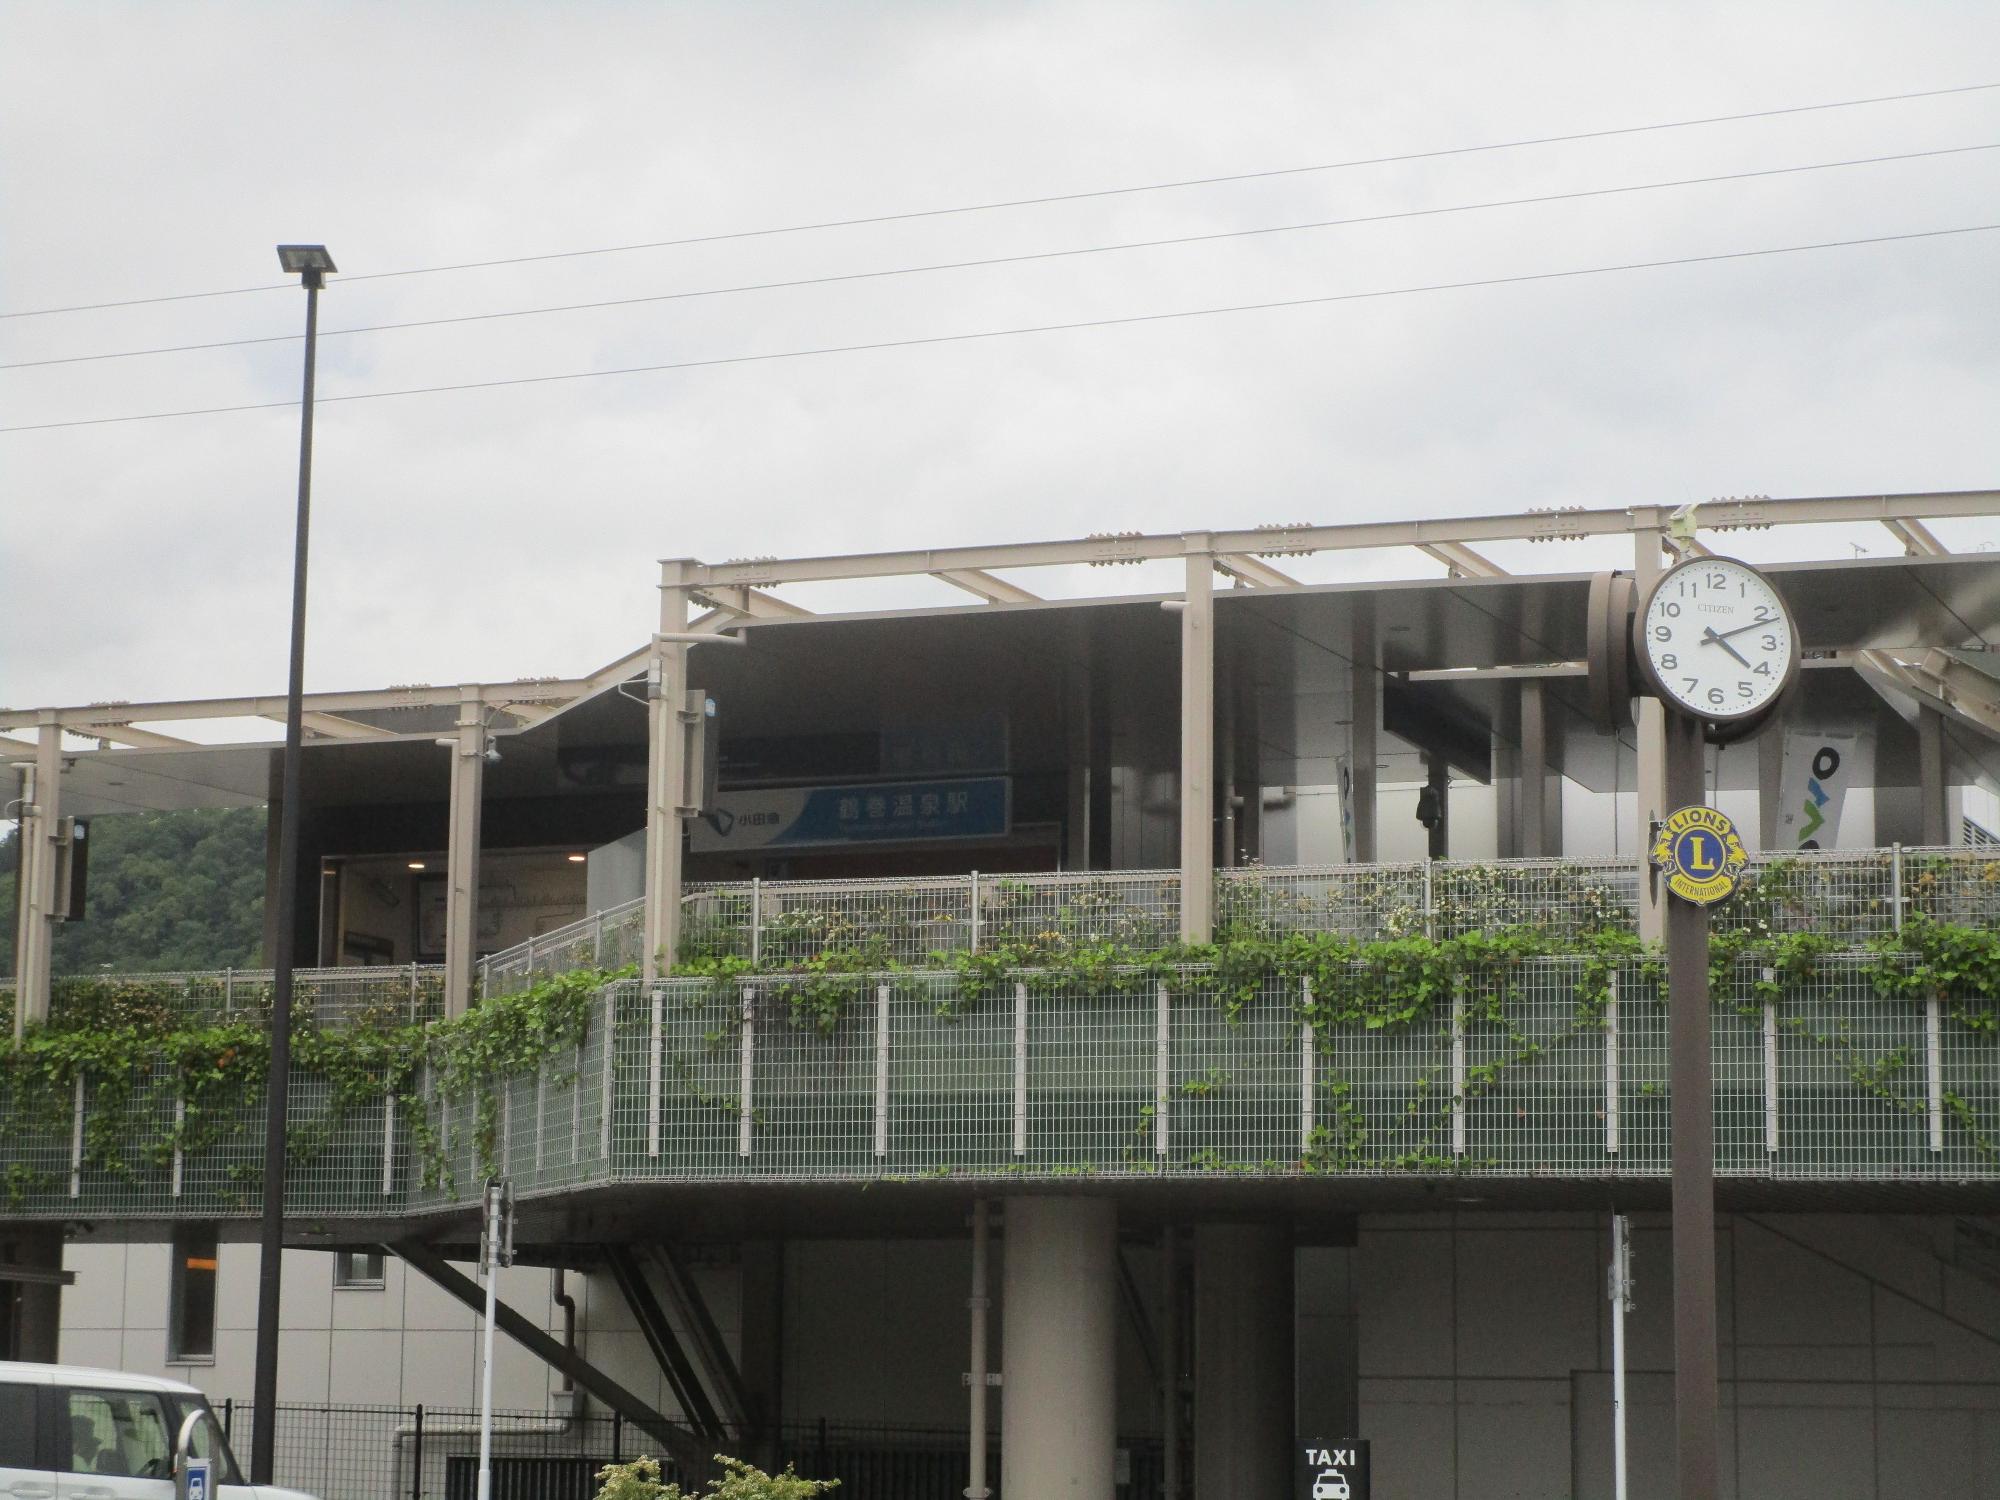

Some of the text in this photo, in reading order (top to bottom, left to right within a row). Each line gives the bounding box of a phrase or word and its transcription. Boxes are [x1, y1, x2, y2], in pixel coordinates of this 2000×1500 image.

[1679, 581, 1697, 598] 11
[1706, 573, 1726, 590] 12
[1739, 582, 1745, 598] 1
[1660, 601, 1681, 618] 10
[1697, 603, 1734, 614] CITIZEN
[1753, 605, 1769, 622] 2
[1655, 625, 1672, 642] 9
[1761, 634, 1777, 651] 3
[1660, 653, 1678, 670] 8
[1753, 661, 1771, 677] 4
[1682, 677, 1699, 693] 7
[1737, 681, 1753, 698] 5
[1707, 687, 1725, 704] 6
[839, 791, 968, 820] 鶴巻温泉駅
[738, 812, 780, 826] 小田急
[1672, 809, 1728, 832] LIONS
[1689, 836, 1716, 870] L
[1674, 878, 1729, 897] INTERNATIONAL
[1305, 1449, 1356, 1466] TAXI
